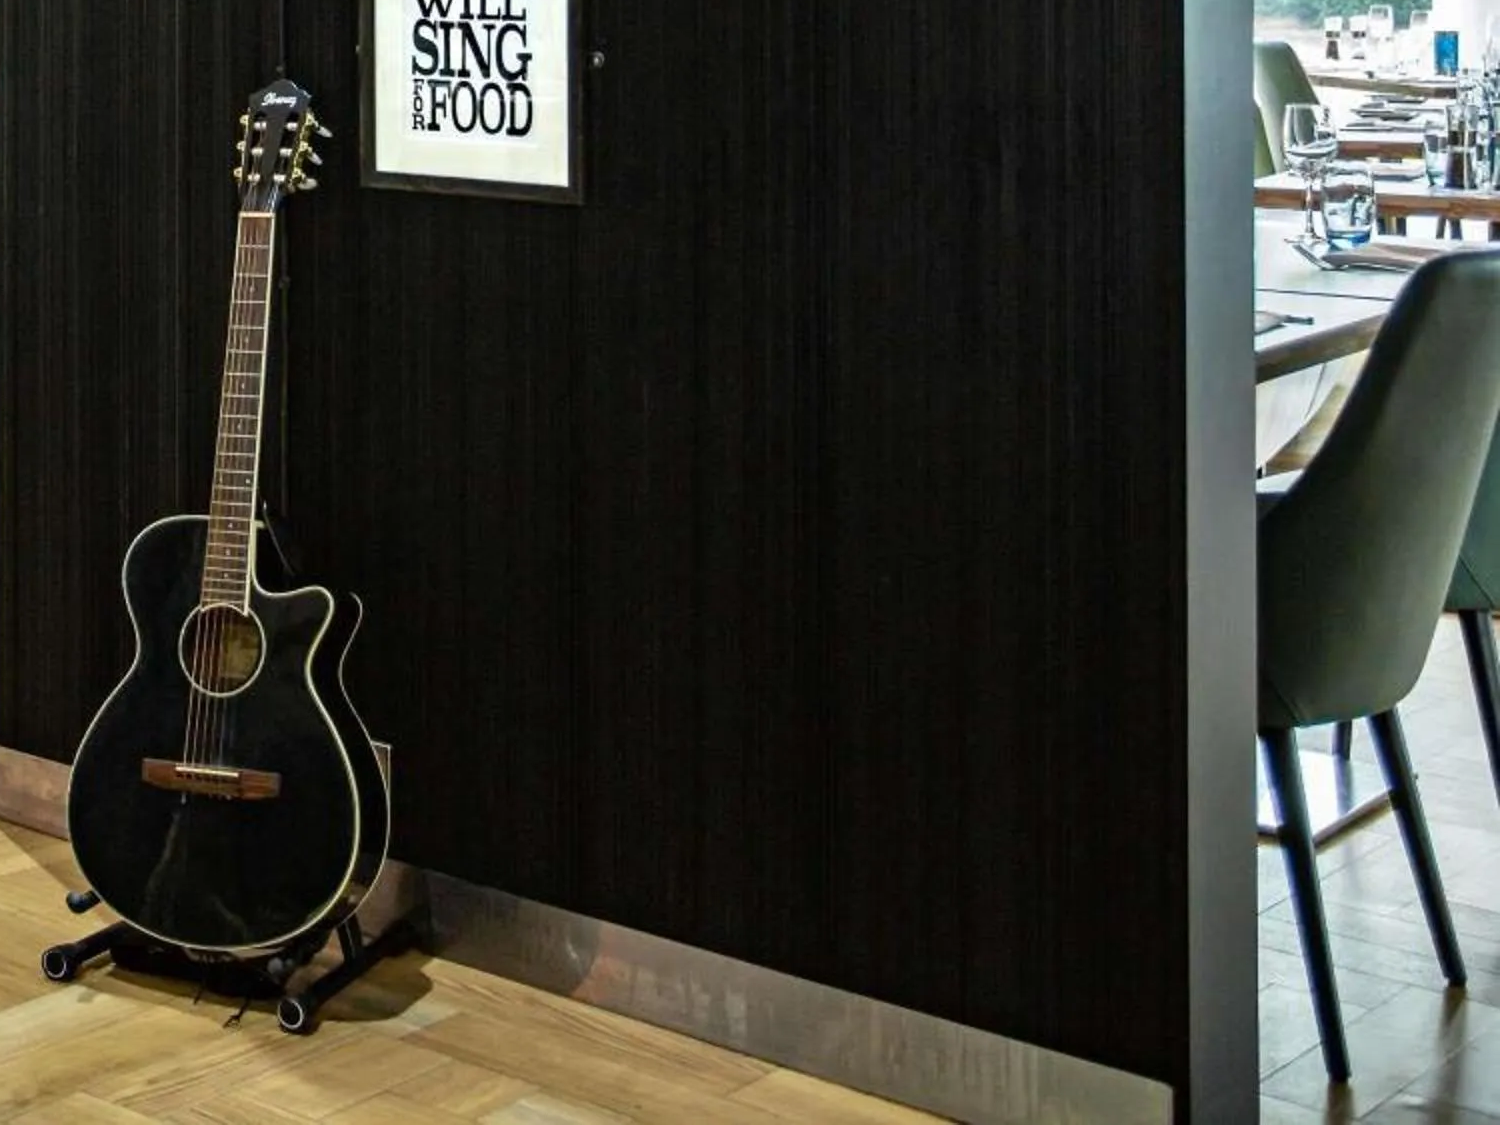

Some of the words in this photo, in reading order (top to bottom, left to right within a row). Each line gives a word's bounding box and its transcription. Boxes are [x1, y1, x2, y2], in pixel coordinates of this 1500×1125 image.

[411, 18, 533, 82] SING
[411, 78, 425, 131] FOR
[427, 79, 533, 138] FOOD
